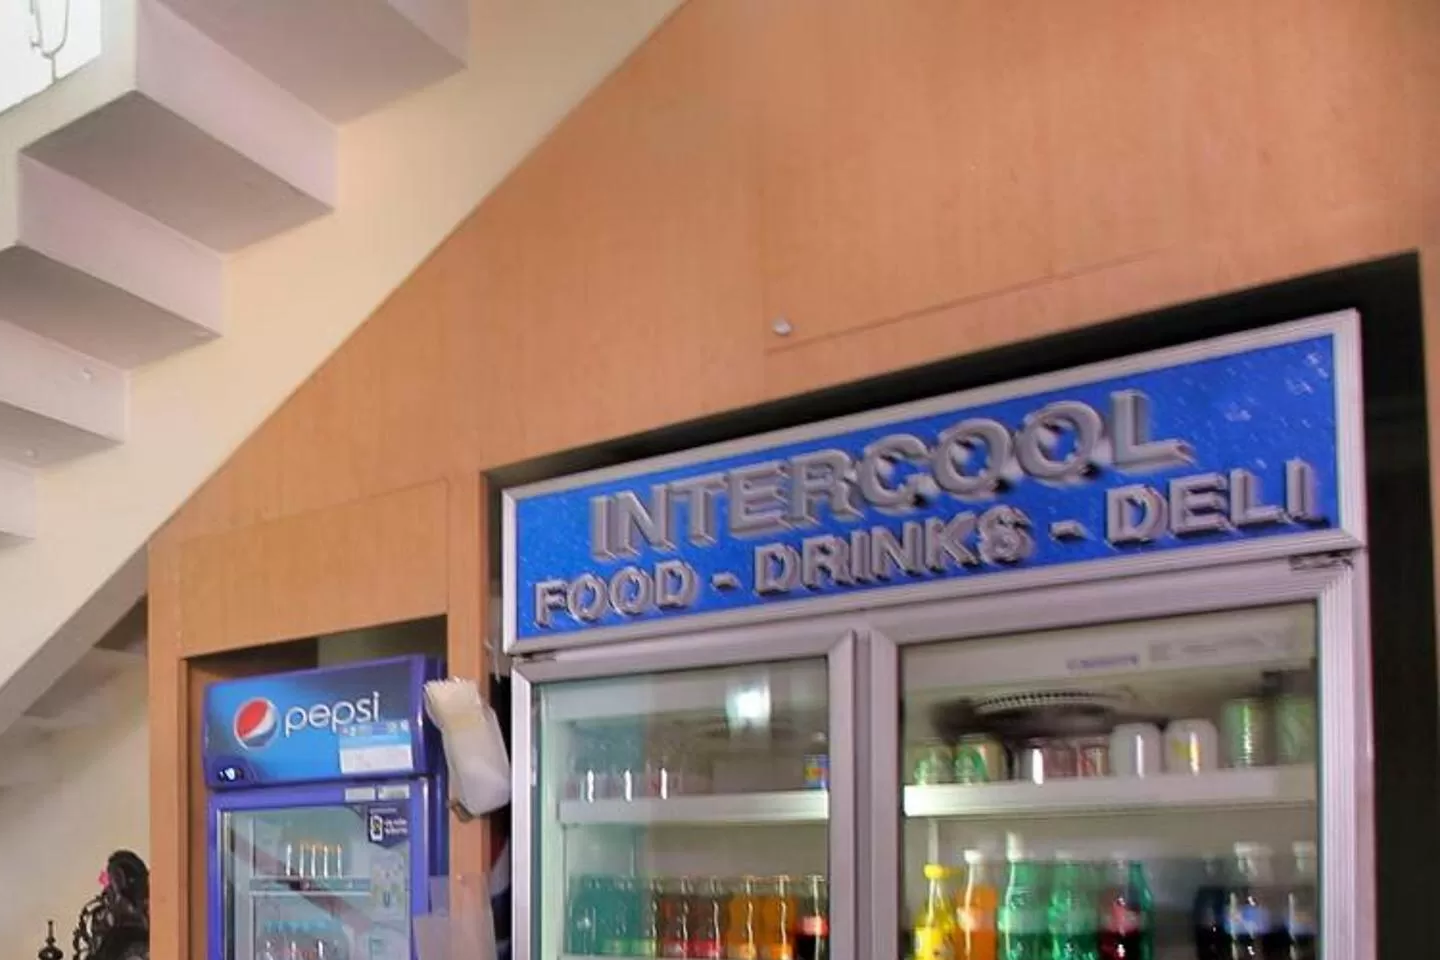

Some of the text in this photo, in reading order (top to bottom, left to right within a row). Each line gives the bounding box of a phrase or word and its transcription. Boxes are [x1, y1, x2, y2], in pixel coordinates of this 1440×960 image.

[534, 559, 699, 628] FOOD
[754, 503, 1035, 596] DRINKS
[1106, 456, 1320, 546] DELI
[591, 388, 1192, 560] INTERCOOL
[285, 691, 380, 738] pepsi
